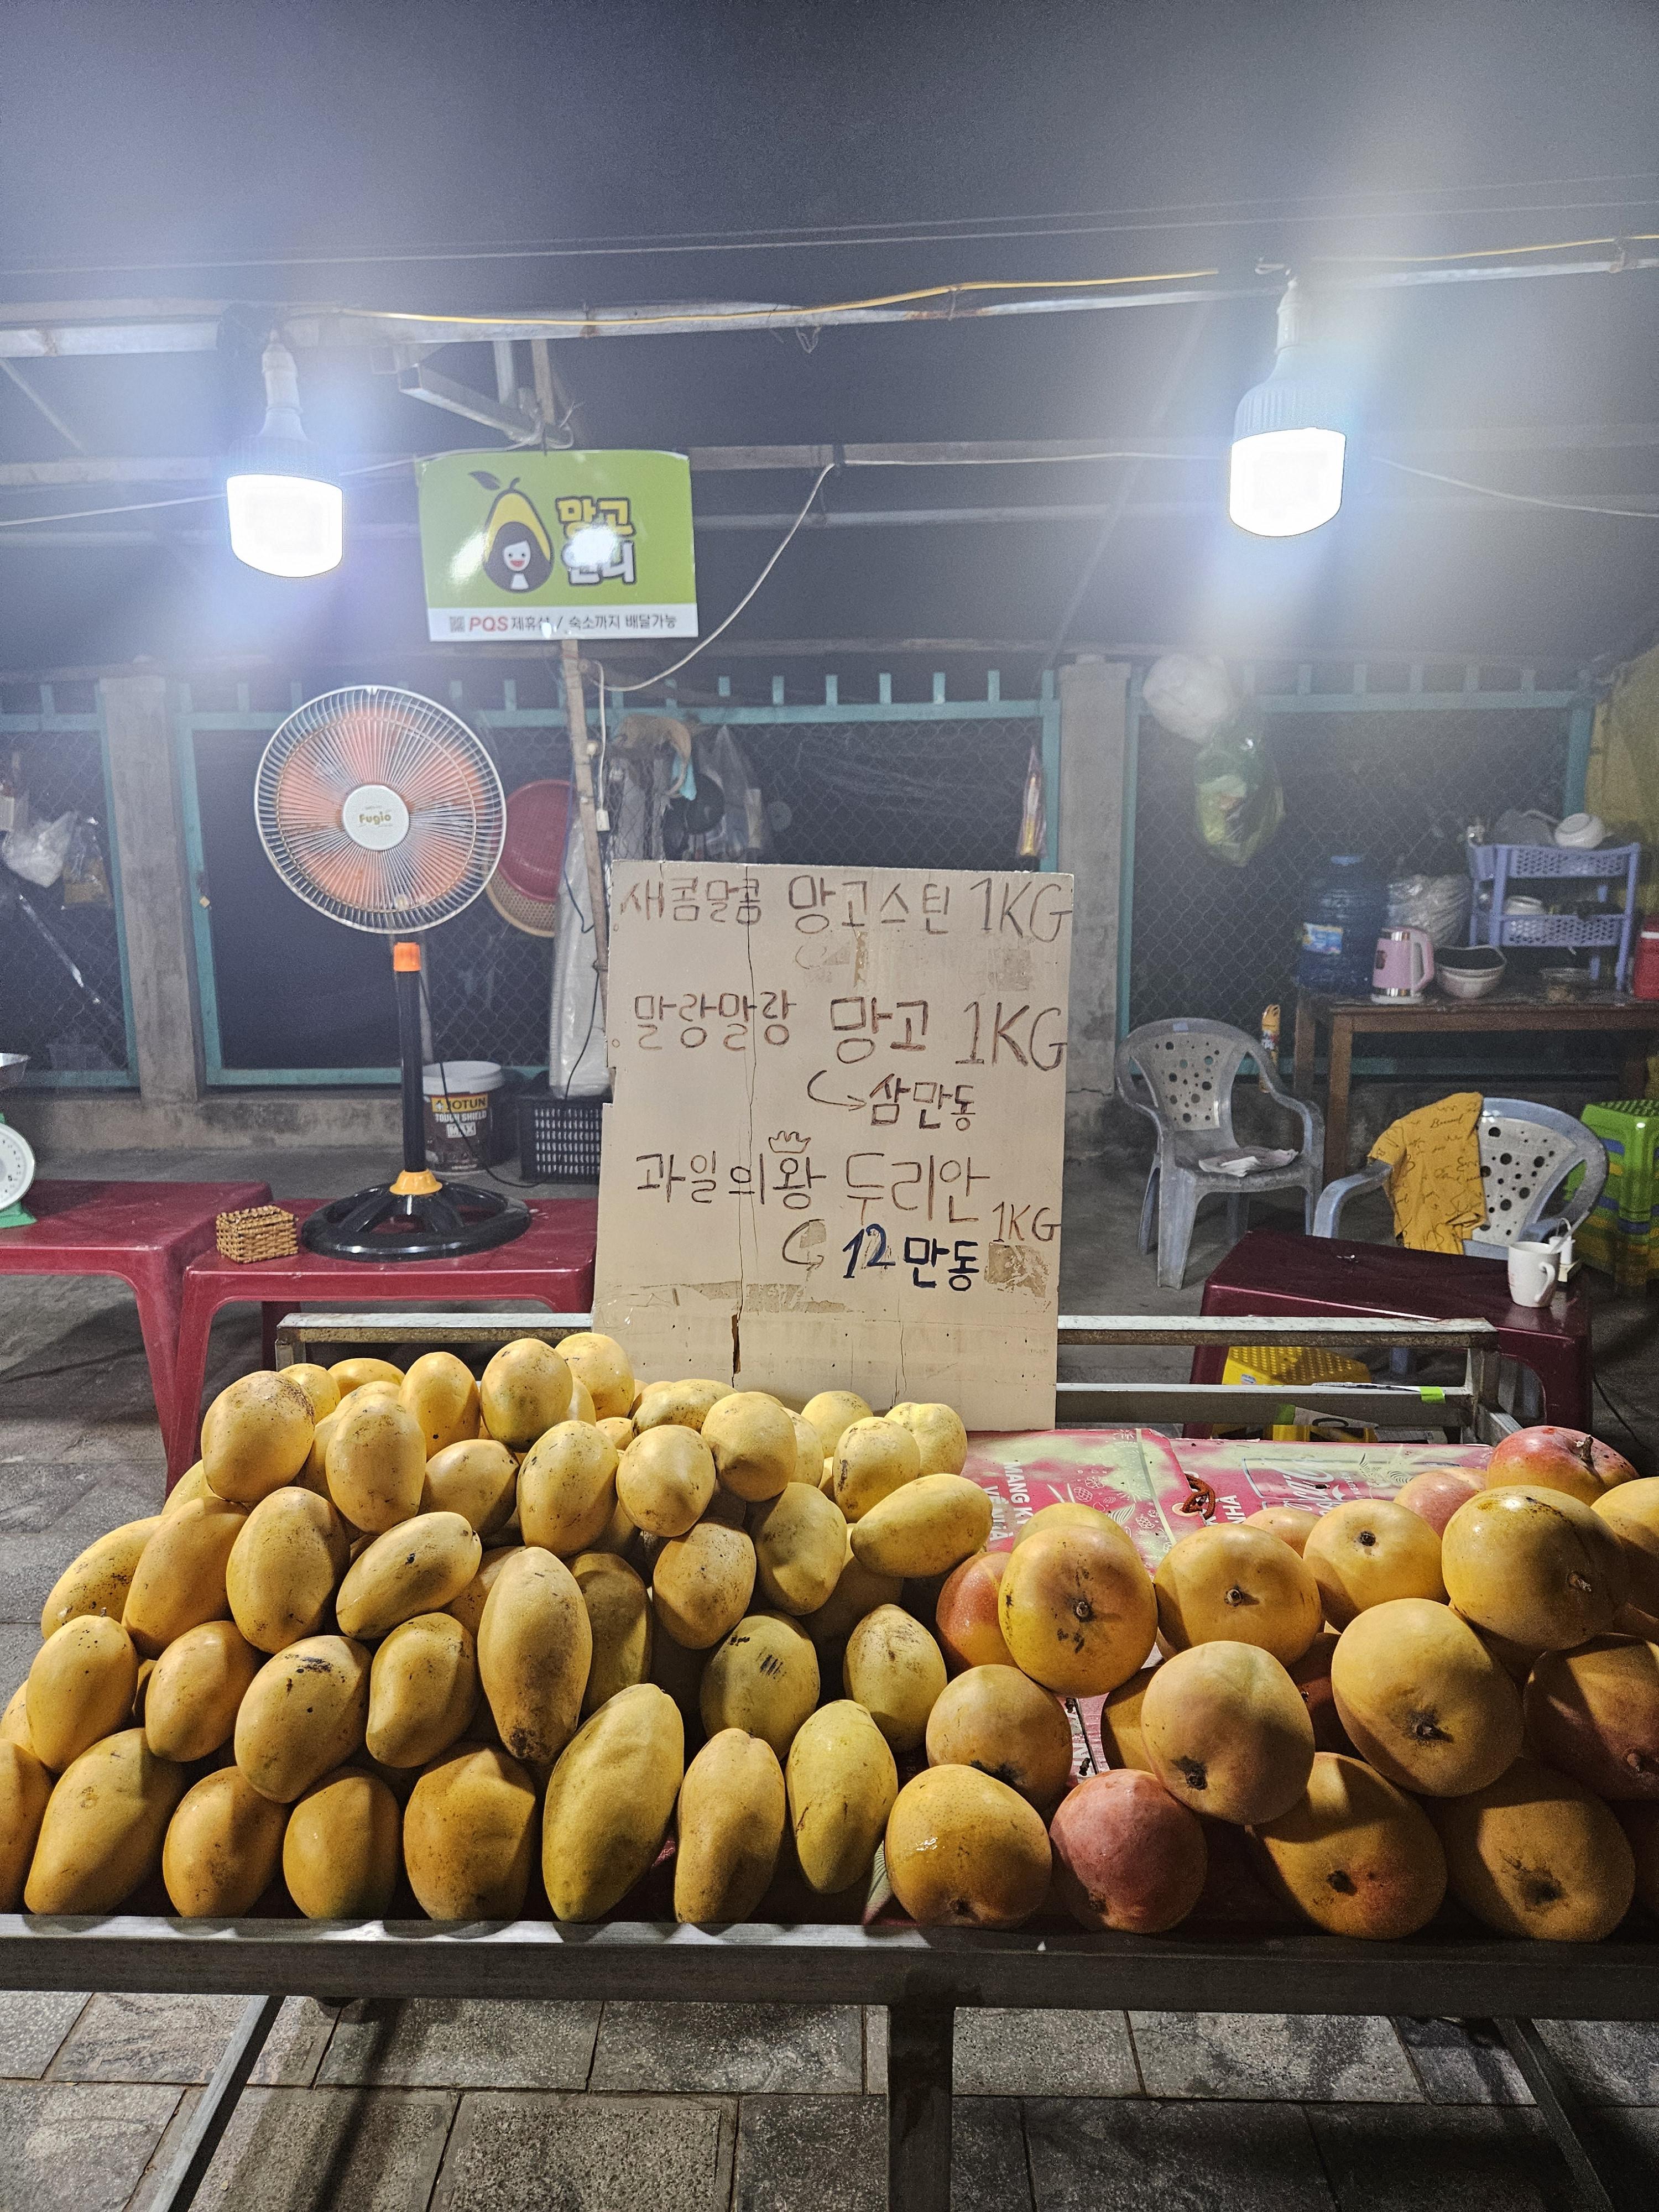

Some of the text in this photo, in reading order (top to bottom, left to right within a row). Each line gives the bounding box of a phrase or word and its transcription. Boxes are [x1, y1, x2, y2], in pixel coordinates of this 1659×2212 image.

[555, 496, 637, 537] 망고
[570, 615, 620, 630] 숙소까지
[625, 614, 677, 629] 배달가능
[359, 811, 392, 825] Fugio
[789, 874, 950, 935] 망고스틴
[970, 877, 1073, 943] 1KG
[635, 989, 1068, 1072] 말랑말랑 망고 1KG
[461, 1110, 487, 1121] SHIELD
[869, 1073, 976, 1131] 삼만동
[846, 1152, 990, 1226] 두리안
[992, 1201, 1062, 1243] 1KG
[1003, 1462, 1030, 1504] MANG
